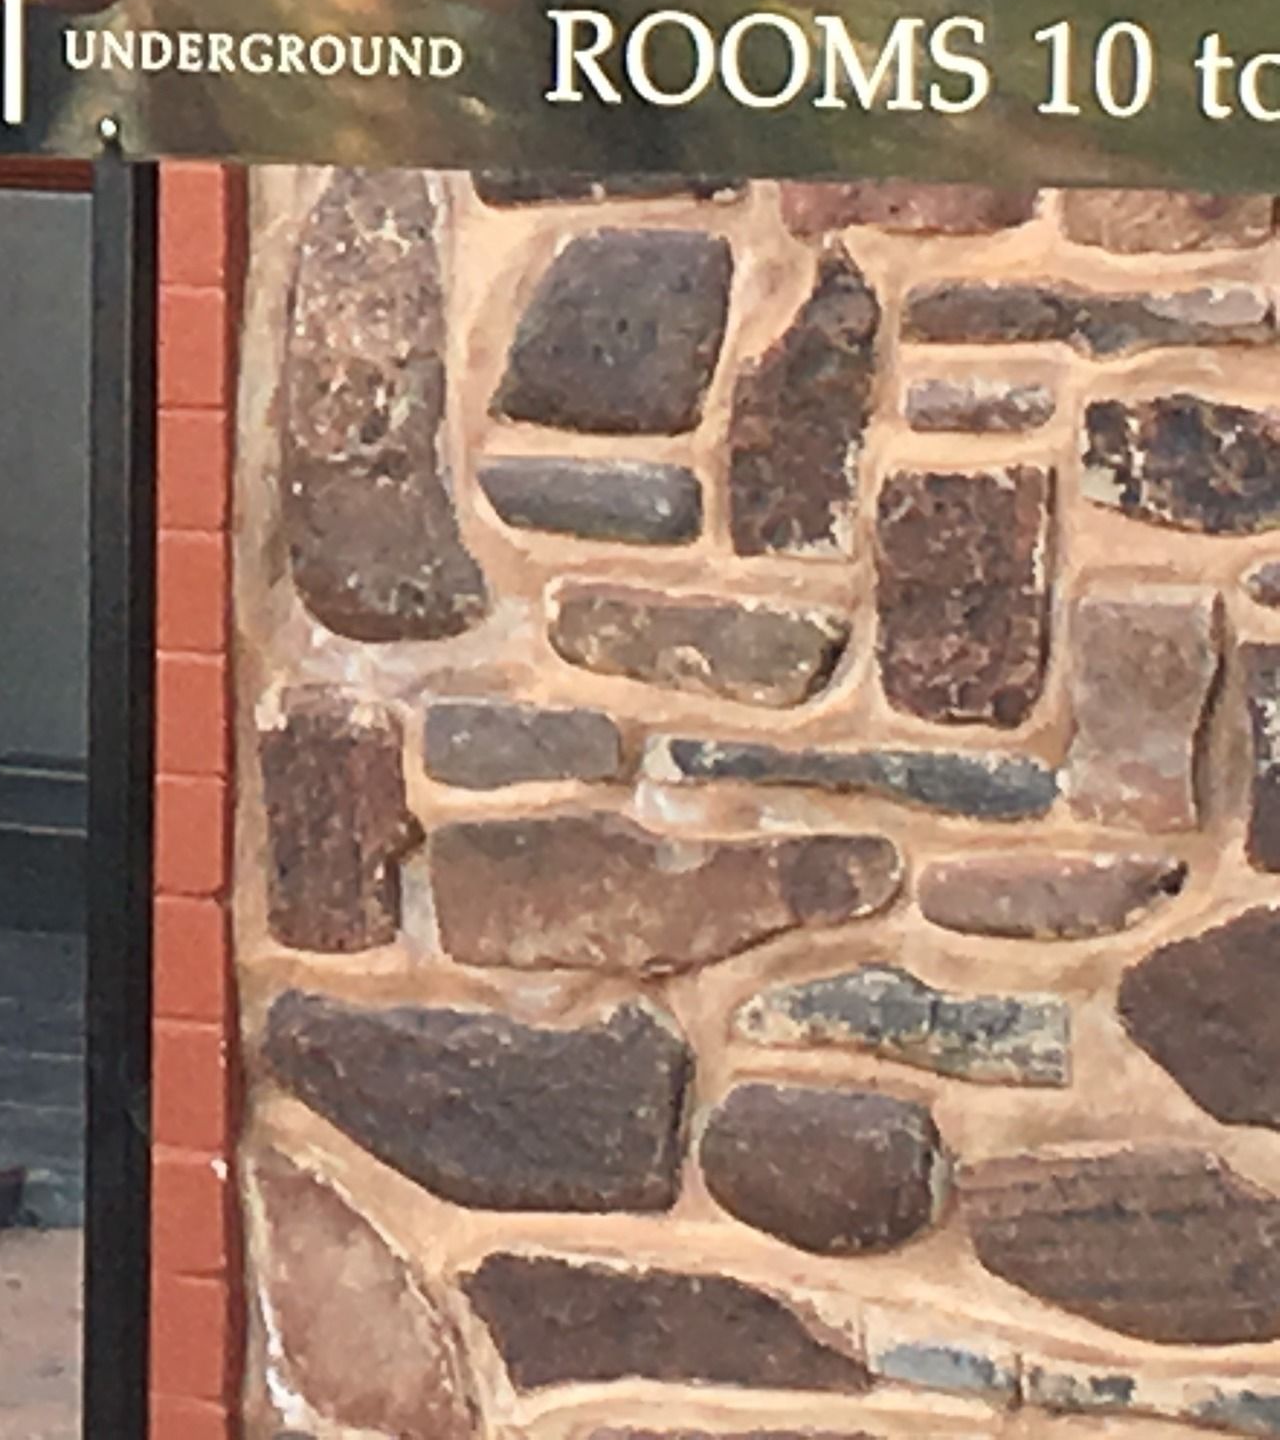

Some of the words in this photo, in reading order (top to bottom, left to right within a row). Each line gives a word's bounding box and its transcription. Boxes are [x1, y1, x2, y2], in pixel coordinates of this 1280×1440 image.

[63, 29, 464, 77] UNDERGROUND
[544, 9, 992, 114] ROOMS
[1034, 20, 1153, 118] 10
[1193, 32, 1280, 122] to
